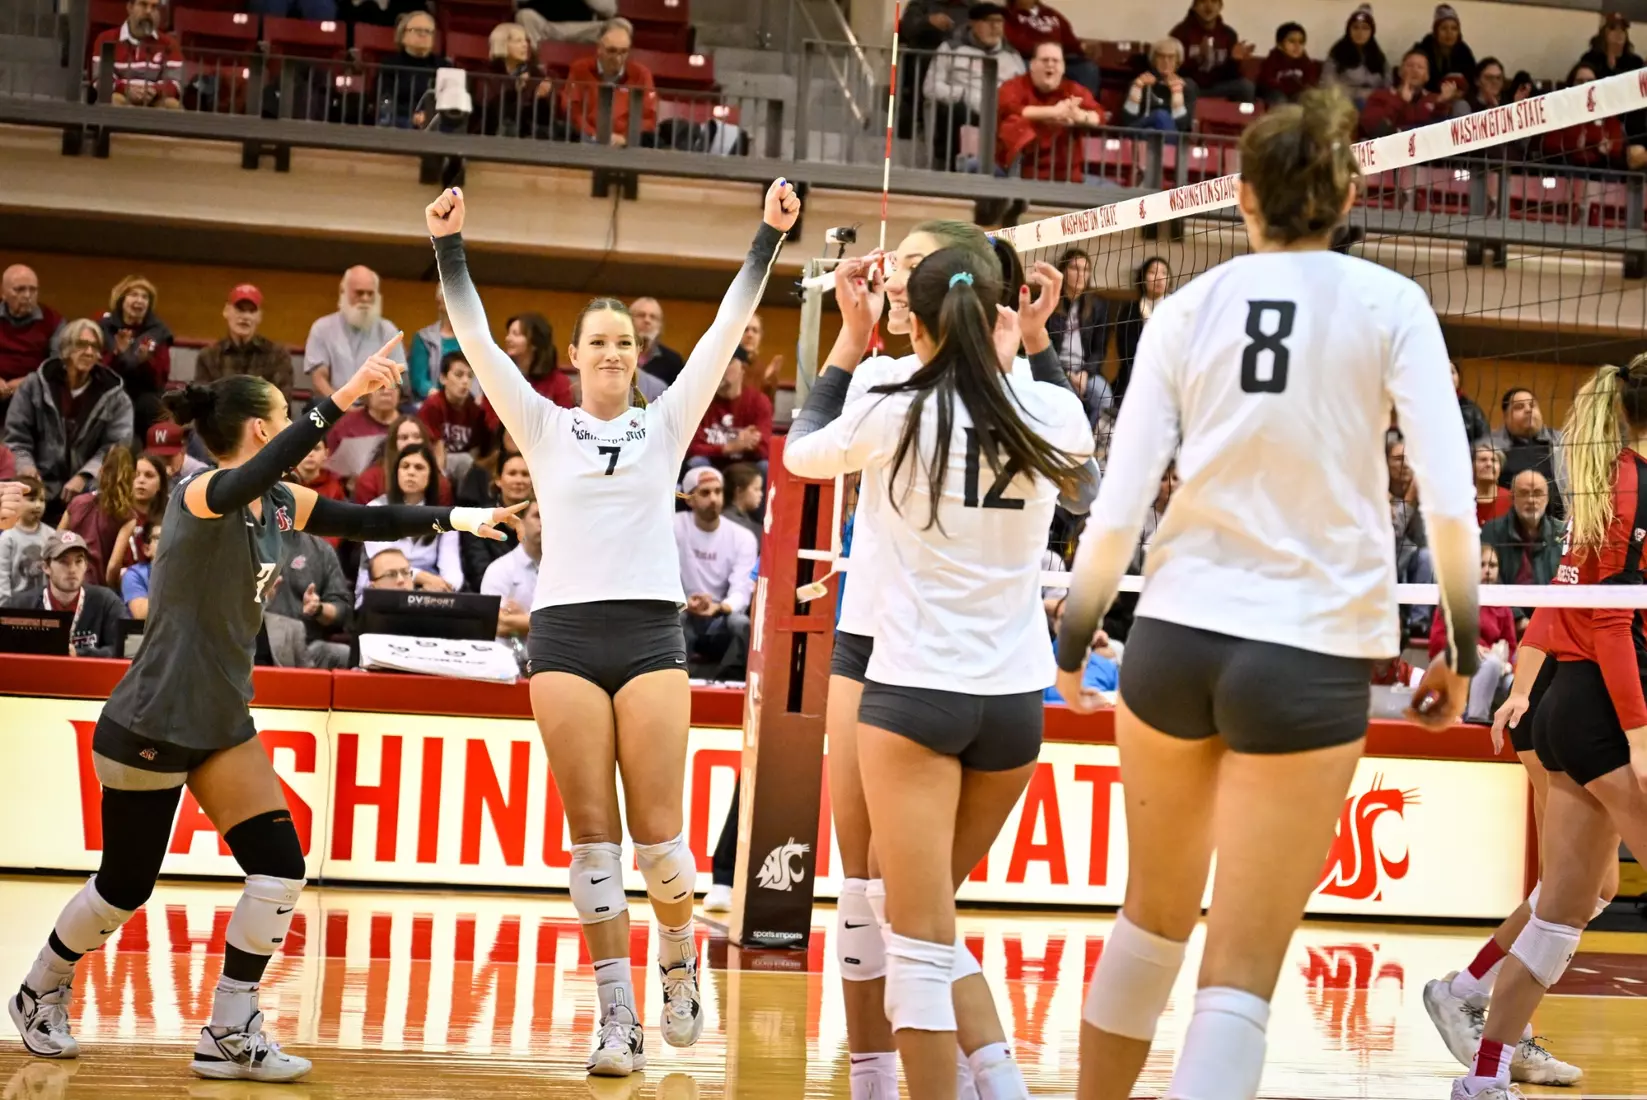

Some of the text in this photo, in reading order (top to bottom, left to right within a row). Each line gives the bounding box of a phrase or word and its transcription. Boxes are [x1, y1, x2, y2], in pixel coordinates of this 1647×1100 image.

[1450, 96, 1547, 147] WASHINGTON STATE
[1168, 175, 1235, 213] WASHINGTON STATE
[1060, 203, 1117, 237] WASHINGTON STATE
[1241, 300, 1296, 393] 8
[155, 428, 167, 443] W
[571, 424, 646, 444] WASHION STATE
[597, 445, 621, 475] 7
[962, 426, 1025, 510] 12
